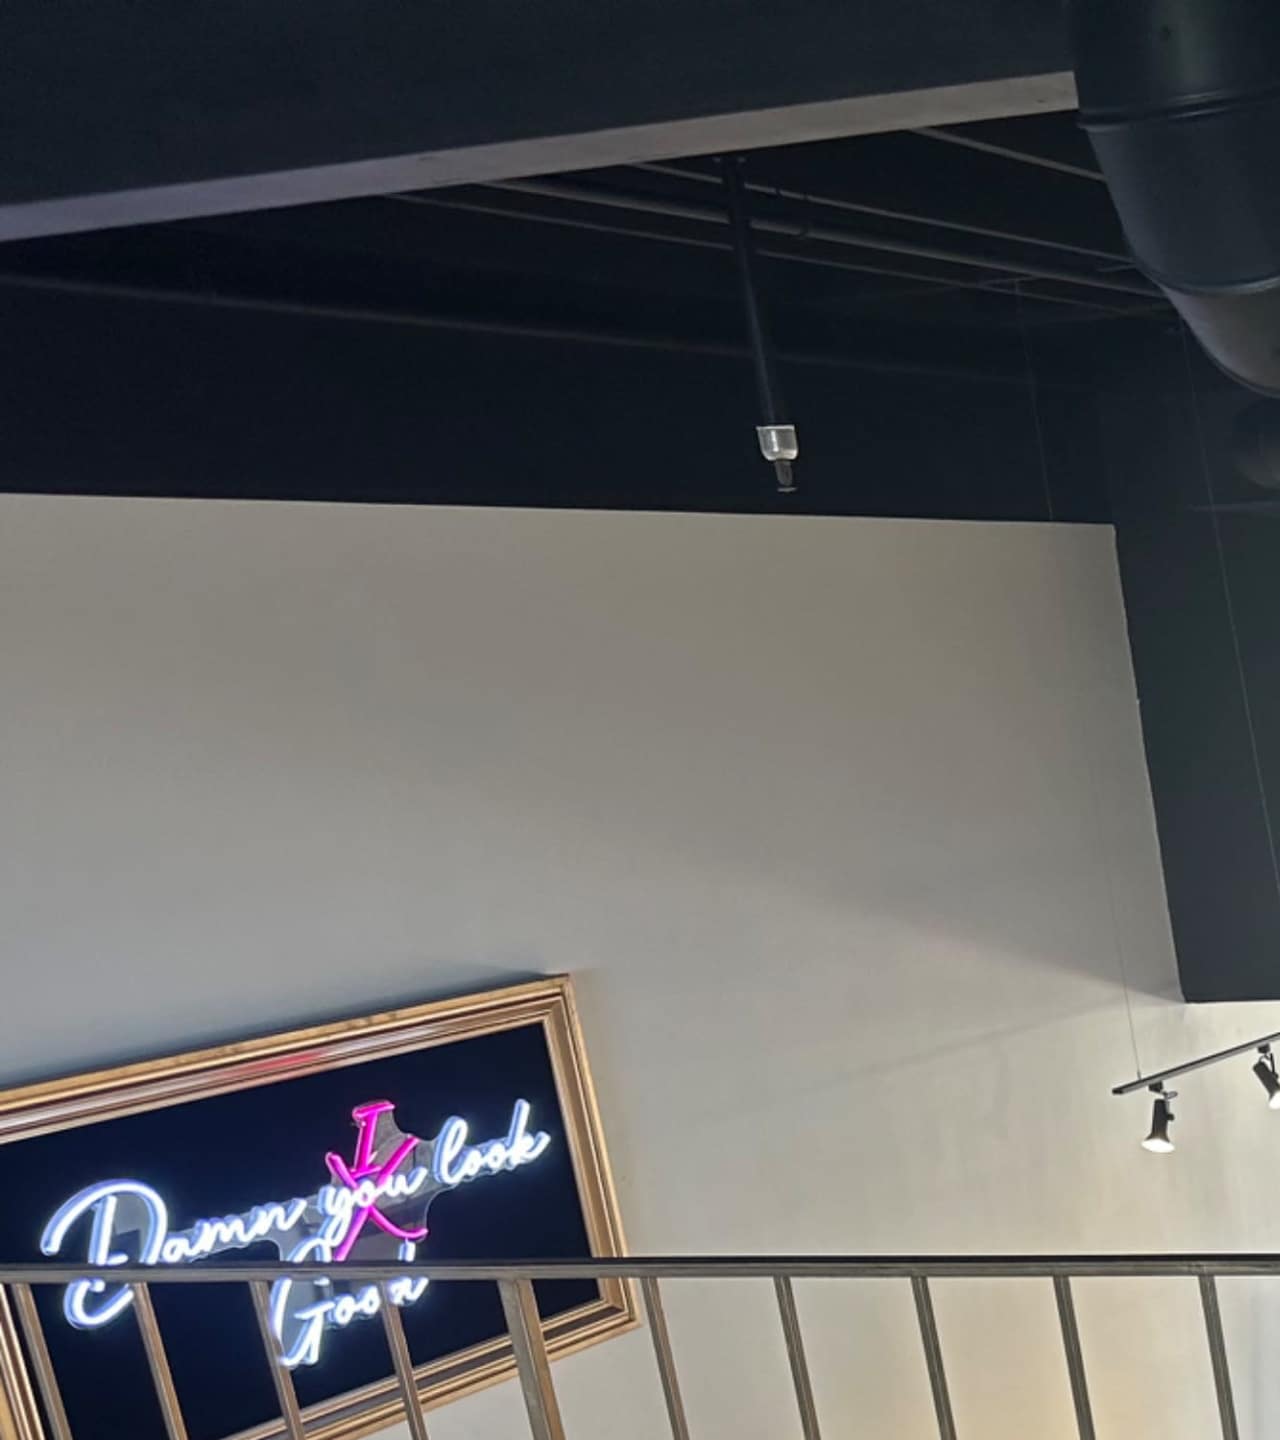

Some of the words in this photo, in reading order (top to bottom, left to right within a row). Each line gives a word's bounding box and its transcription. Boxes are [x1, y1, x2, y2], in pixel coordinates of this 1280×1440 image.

[40, 1178, 306, 1329] Damn
[317, 1166, 429, 1248] you
[432, 1098, 552, 1185] look
[269, 1236, 430, 1368] Good
